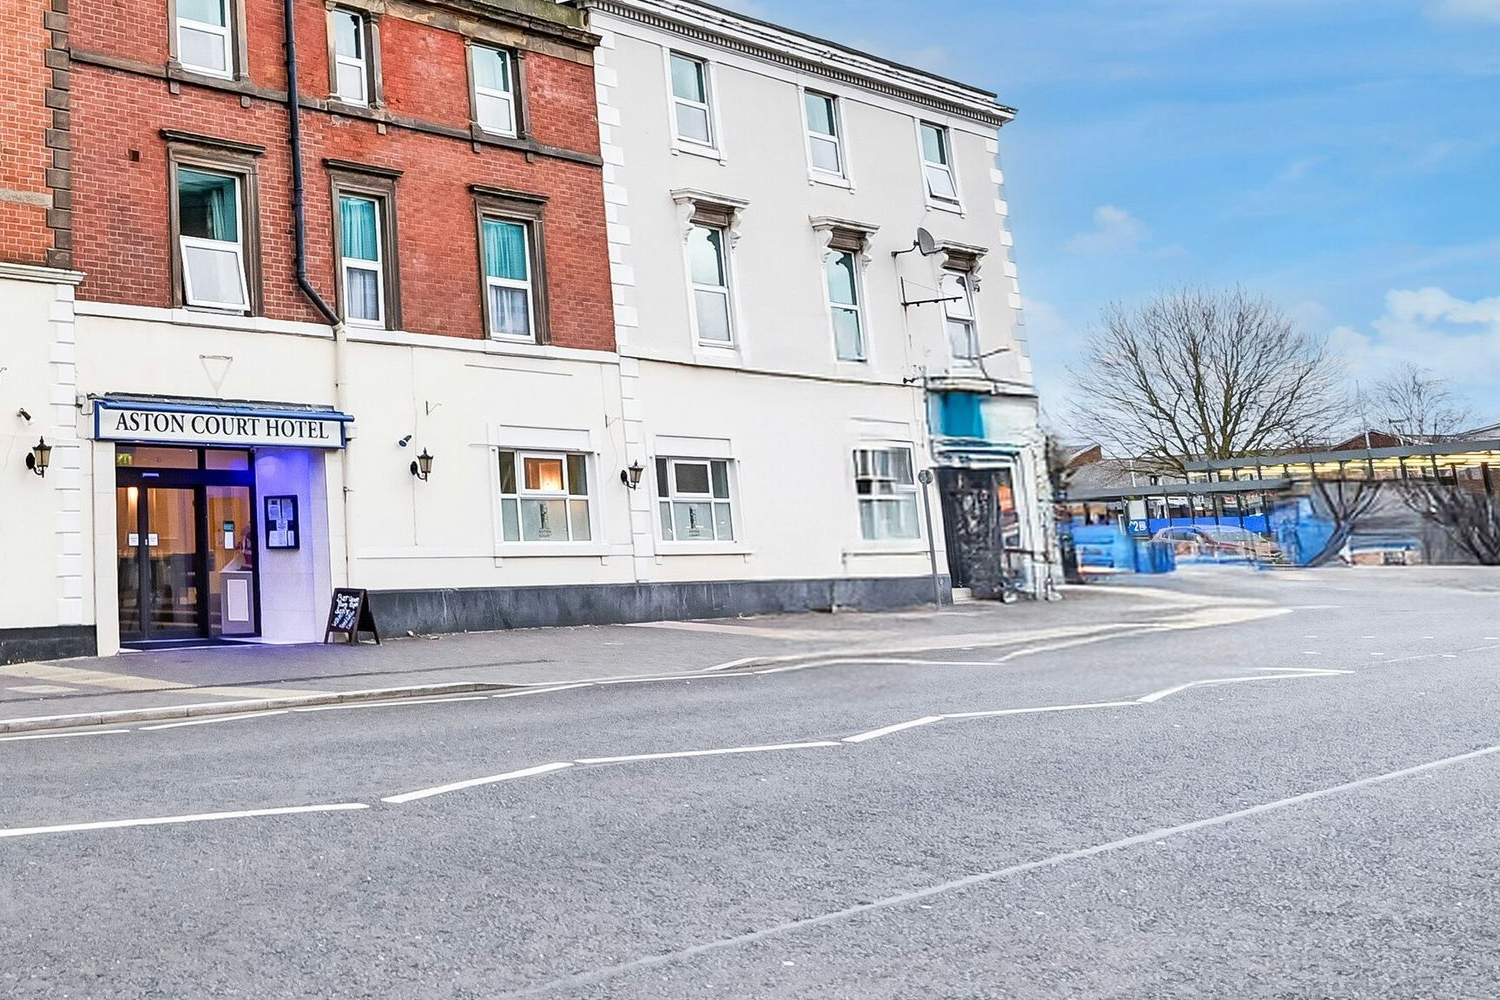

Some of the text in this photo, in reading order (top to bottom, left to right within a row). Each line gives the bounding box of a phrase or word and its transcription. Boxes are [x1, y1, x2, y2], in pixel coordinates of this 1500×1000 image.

[115, 411, 330, 439] ASTON COURT HOTEL
